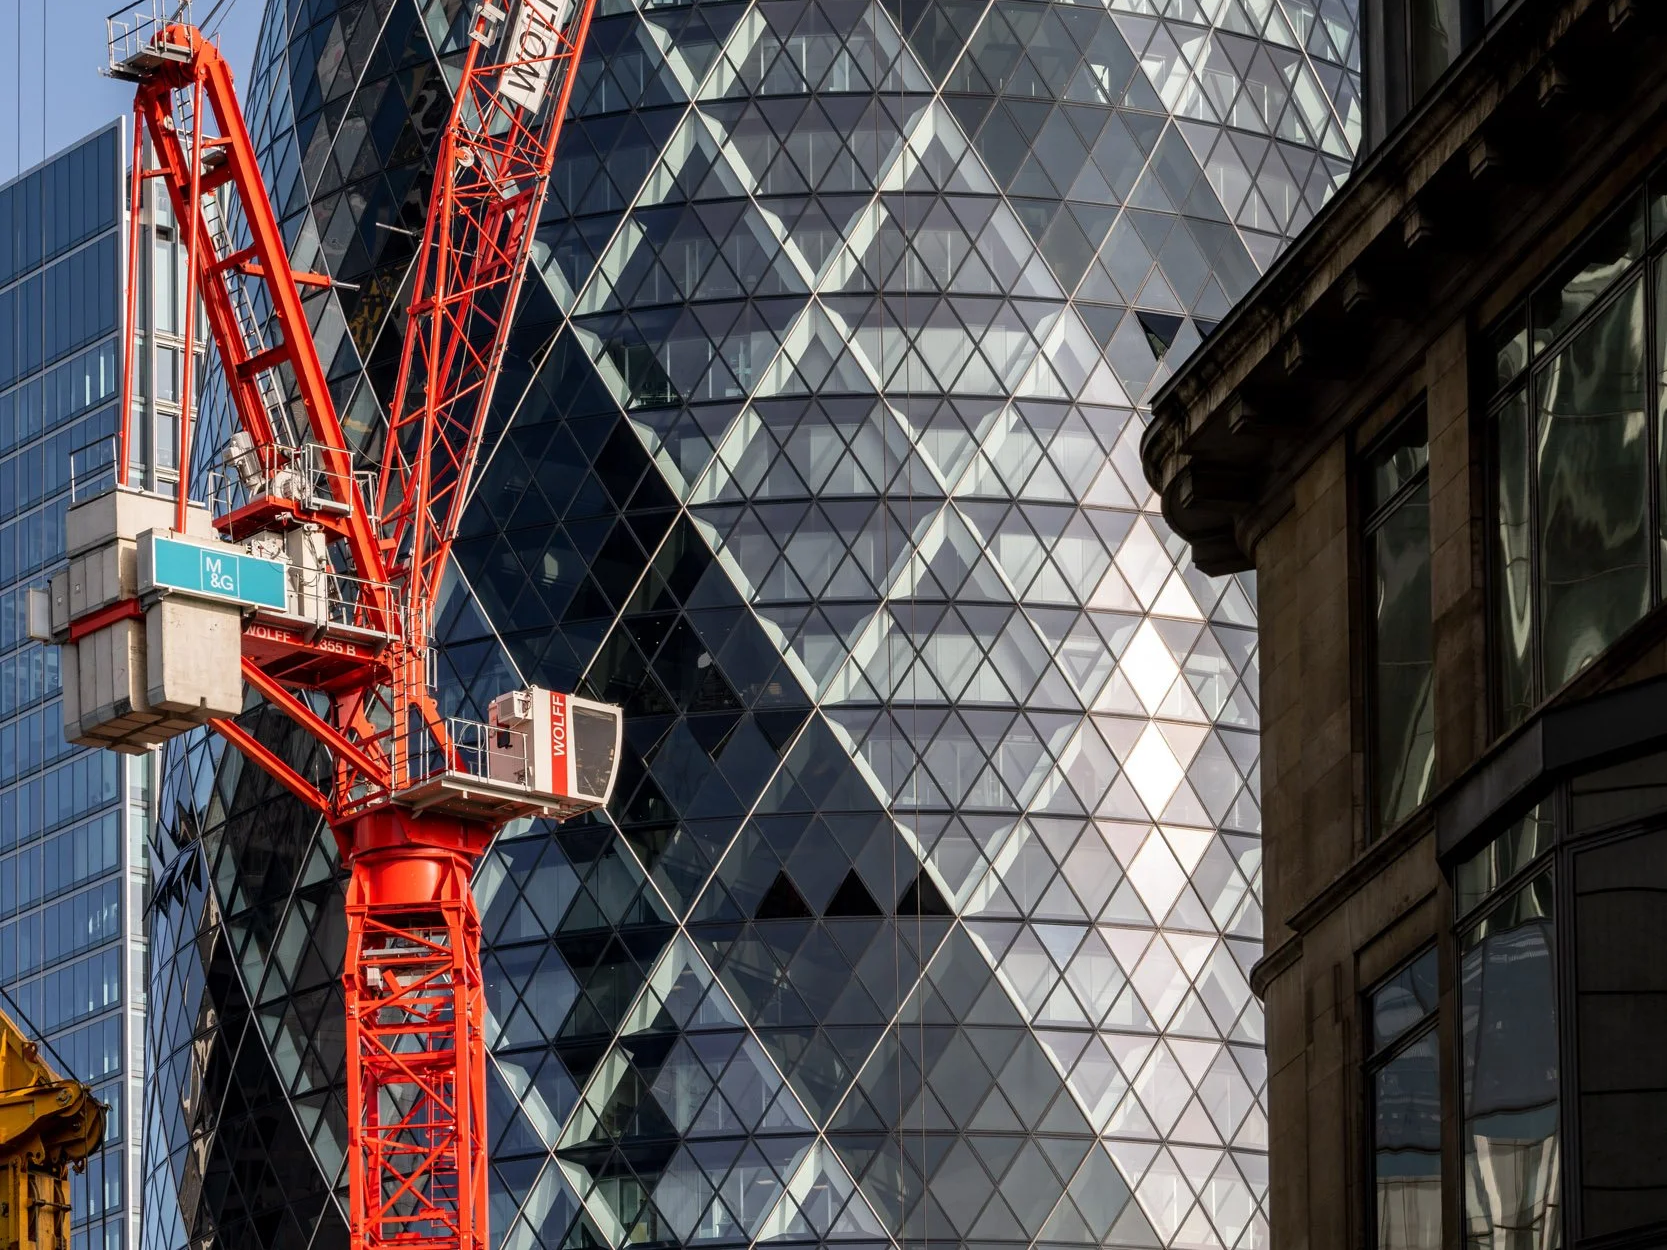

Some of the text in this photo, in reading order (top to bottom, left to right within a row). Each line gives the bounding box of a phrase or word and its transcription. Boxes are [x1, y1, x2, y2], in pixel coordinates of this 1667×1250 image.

[206, 556, 222, 575] M
[211, 573, 234, 591] &G
[320, 639, 343, 654] 355
[346, 644, 356, 656] B
[552, 695, 565, 756] WOLFF
